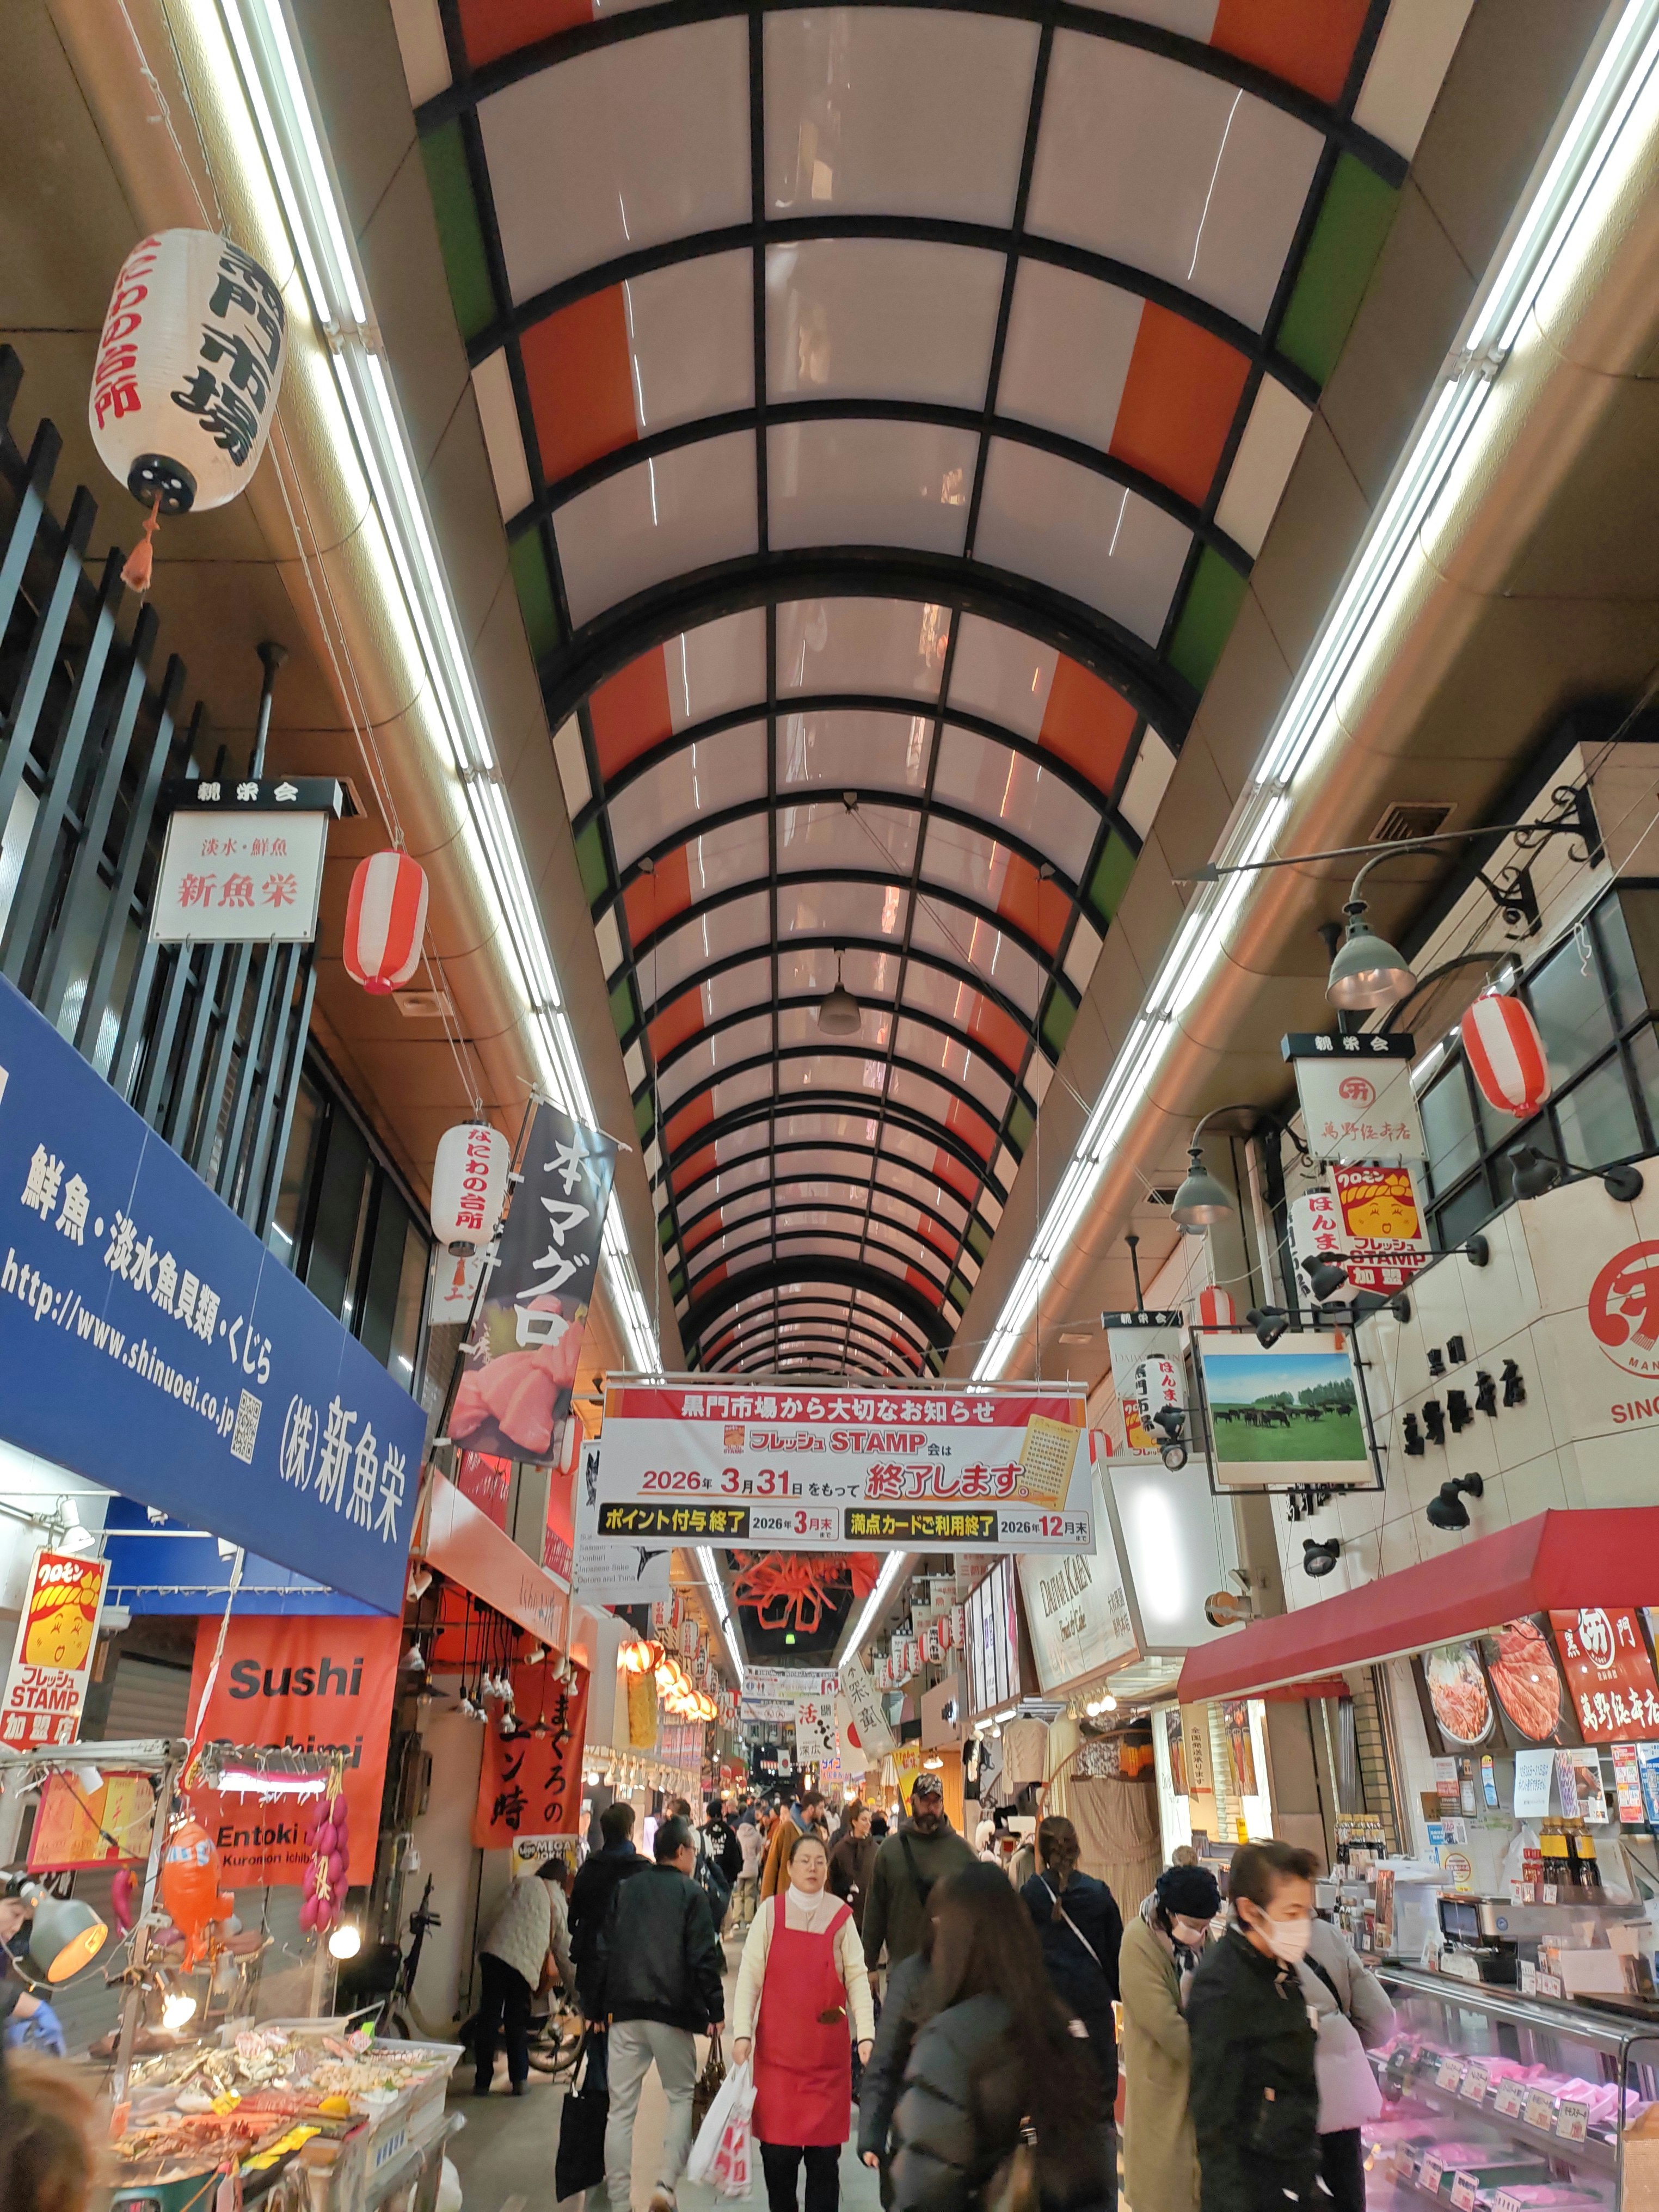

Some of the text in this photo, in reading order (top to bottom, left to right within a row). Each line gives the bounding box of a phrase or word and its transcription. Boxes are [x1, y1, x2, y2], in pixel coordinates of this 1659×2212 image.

[197, 782, 299, 802] 親栄会
[202, 837, 288, 857] 淡水・鮮魚
[178, 872, 299, 909] 新魚栄
[1315, 1036, 1389, 1051] 親栄会
[456, 1127, 493, 1230] なにわの台所
[1338, 1171, 1384, 1188] クロモン
[515, 1132, 601, 1347] 本マグロ
[1354, 1238, 1416, 1251] フレッシュ
[1350, 1250, 1425, 1265] STAMP
[1354, 1268, 1410, 1286] 加盟
[1120, 1313, 1166, 1324] 親栄会
[1, 1248, 234, 1437] http://www.shinuoei.co.jp
[681, 1394, 995, 1423] 黒門市場から大切なお知らせ
[831, 1430, 927, 1455] STAMP
[642, 1461, 1029, 1499] 2026年 3月31日 をもって 終了します。
[605, 1508, 746, 1533] ポイント付与終了
[851, 1513, 994, 1537] 満点カードご利用終了
[578, 1565, 610, 1574] Japanese
[579, 1554, 605, 1562] Donburi
[39, 1562, 84, 1587] クロモン
[1040, 1554, 1092, 1618] DAIWA KAEN
[22, 1667, 75, 1689] フレッシュ
[229, 1657, 364, 1699] Sushi
[11, 1686, 79, 1711] STAMP
[3, 1712, 75, 1742] 加盟店
[1191, 1726, 1205, 1785] 全国発送承ります
[217, 1824, 297, 1847] Entoki
[537, 1840, 572, 1851] MEGA
[223, 1853, 281, 1866] Kuromon
